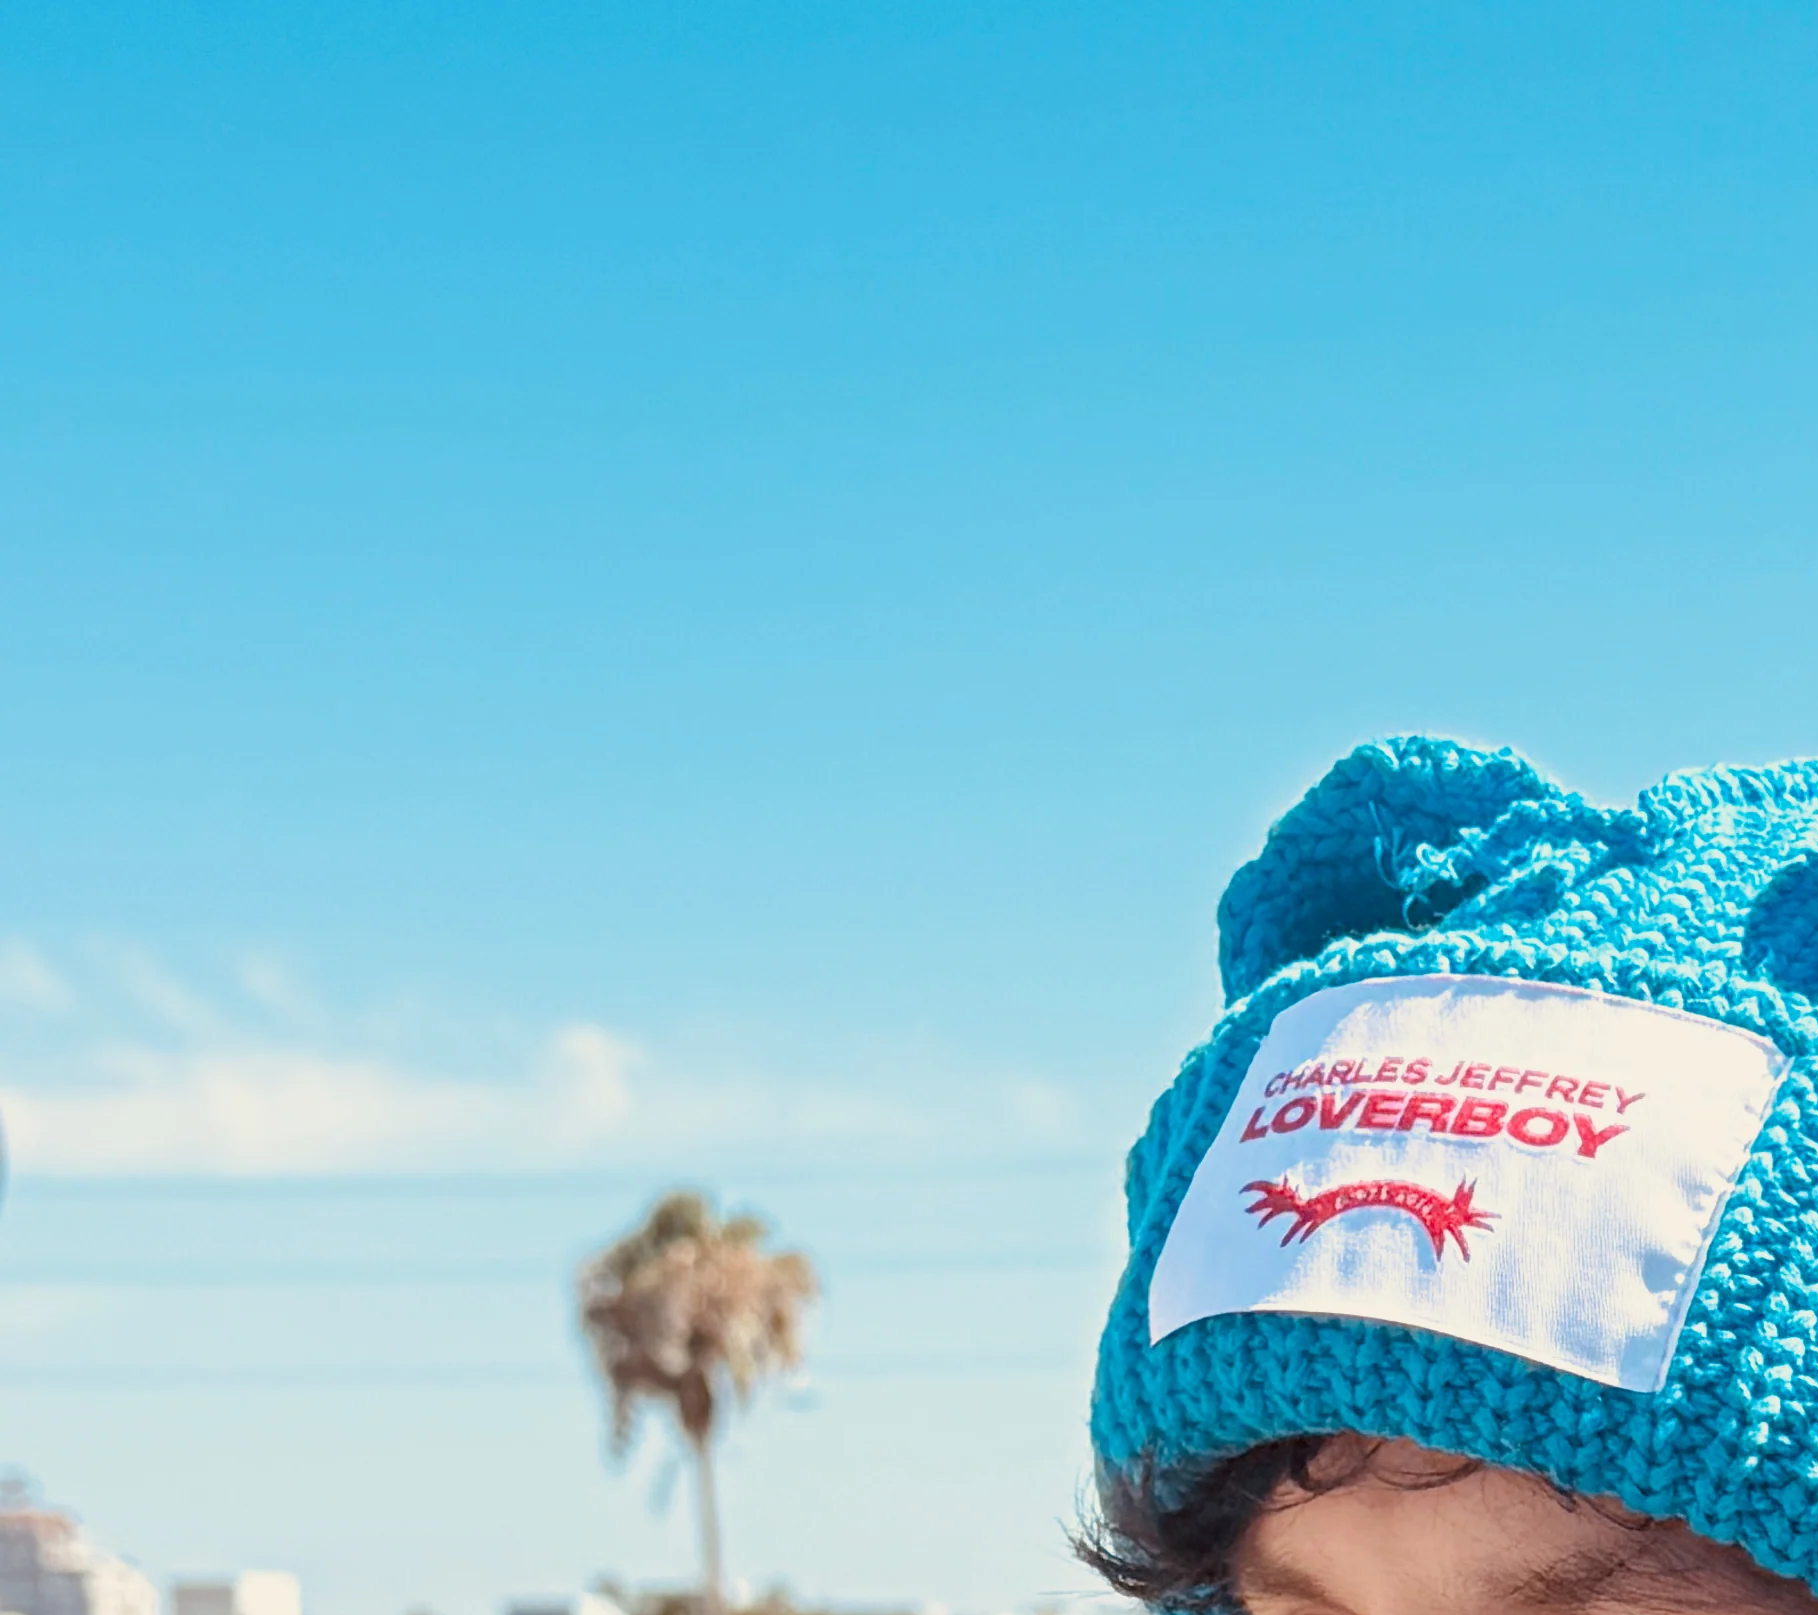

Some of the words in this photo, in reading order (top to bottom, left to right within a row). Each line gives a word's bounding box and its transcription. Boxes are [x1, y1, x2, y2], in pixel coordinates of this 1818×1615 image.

[1264, 1056, 1433, 1098] CHARLES
[1434, 1060, 1647, 1115] JEFFREY
[1239, 1088, 1632, 1158] LOVERBOY
